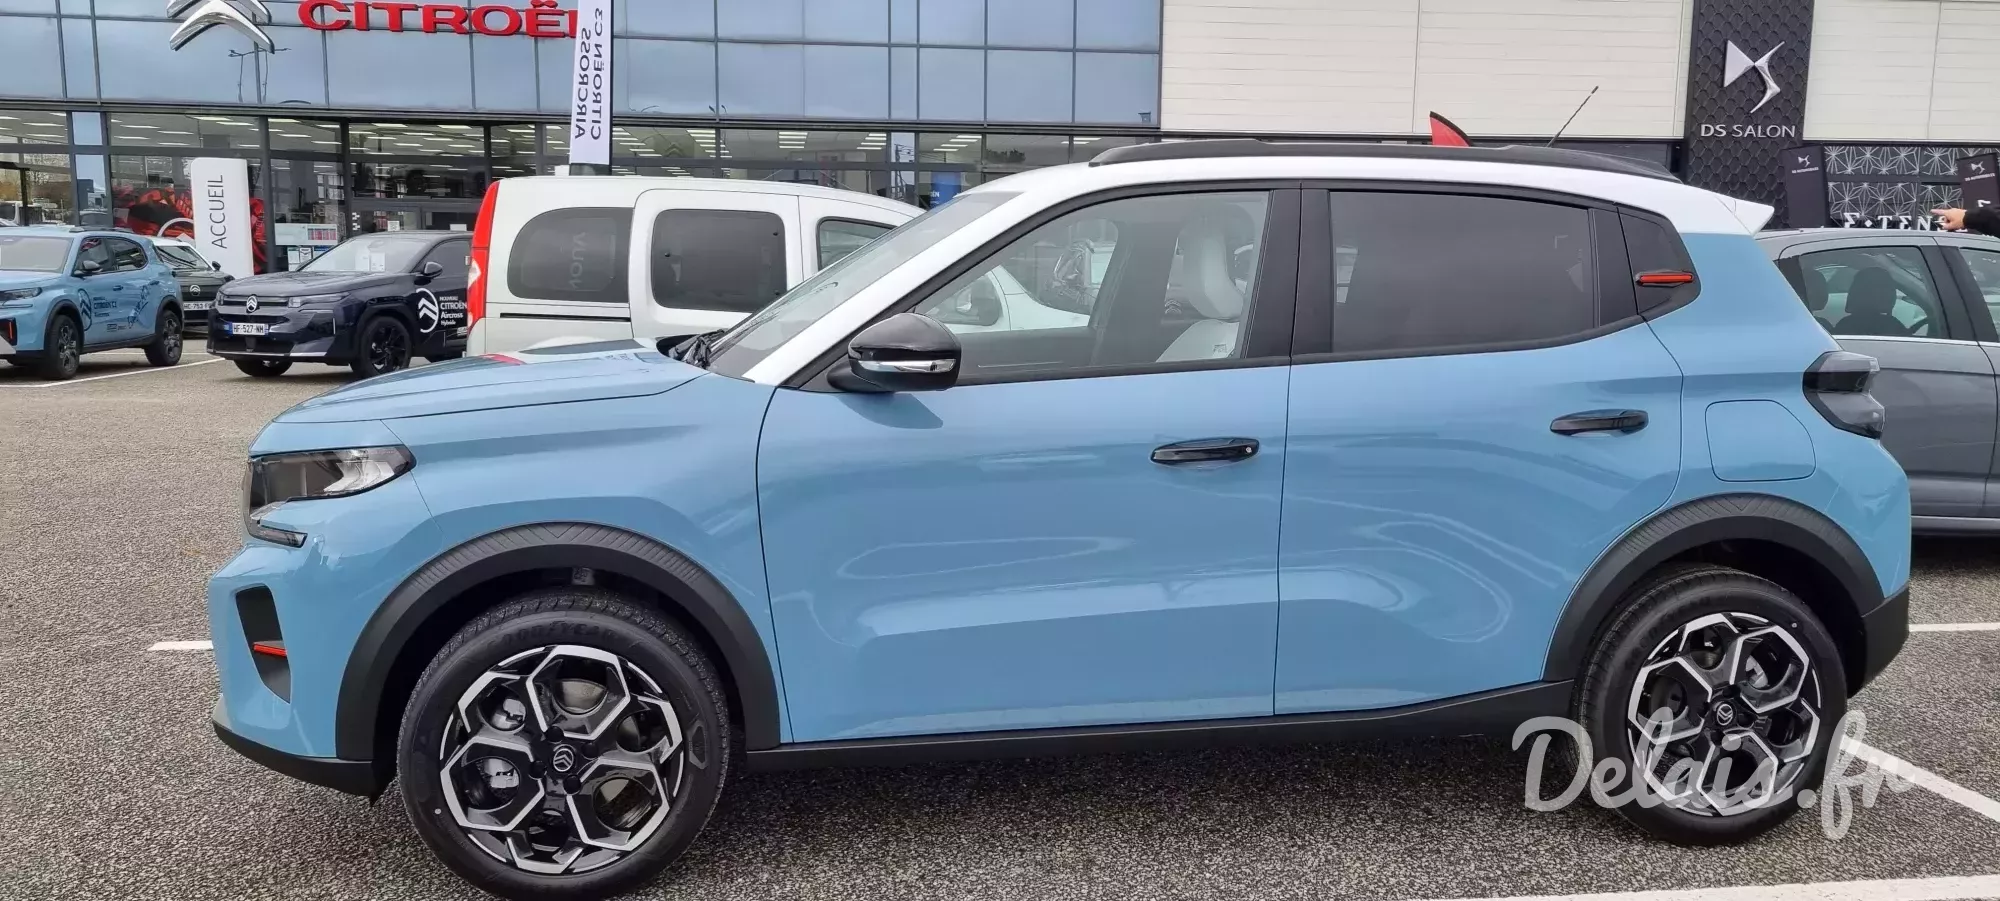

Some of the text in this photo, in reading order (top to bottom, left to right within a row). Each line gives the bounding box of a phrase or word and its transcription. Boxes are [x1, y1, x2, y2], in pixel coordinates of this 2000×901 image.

[1700, 124, 1796, 138] DS SALON
[207, 175, 227, 249] ACCUEIL
[440, 311, 464, 319] Aircross
